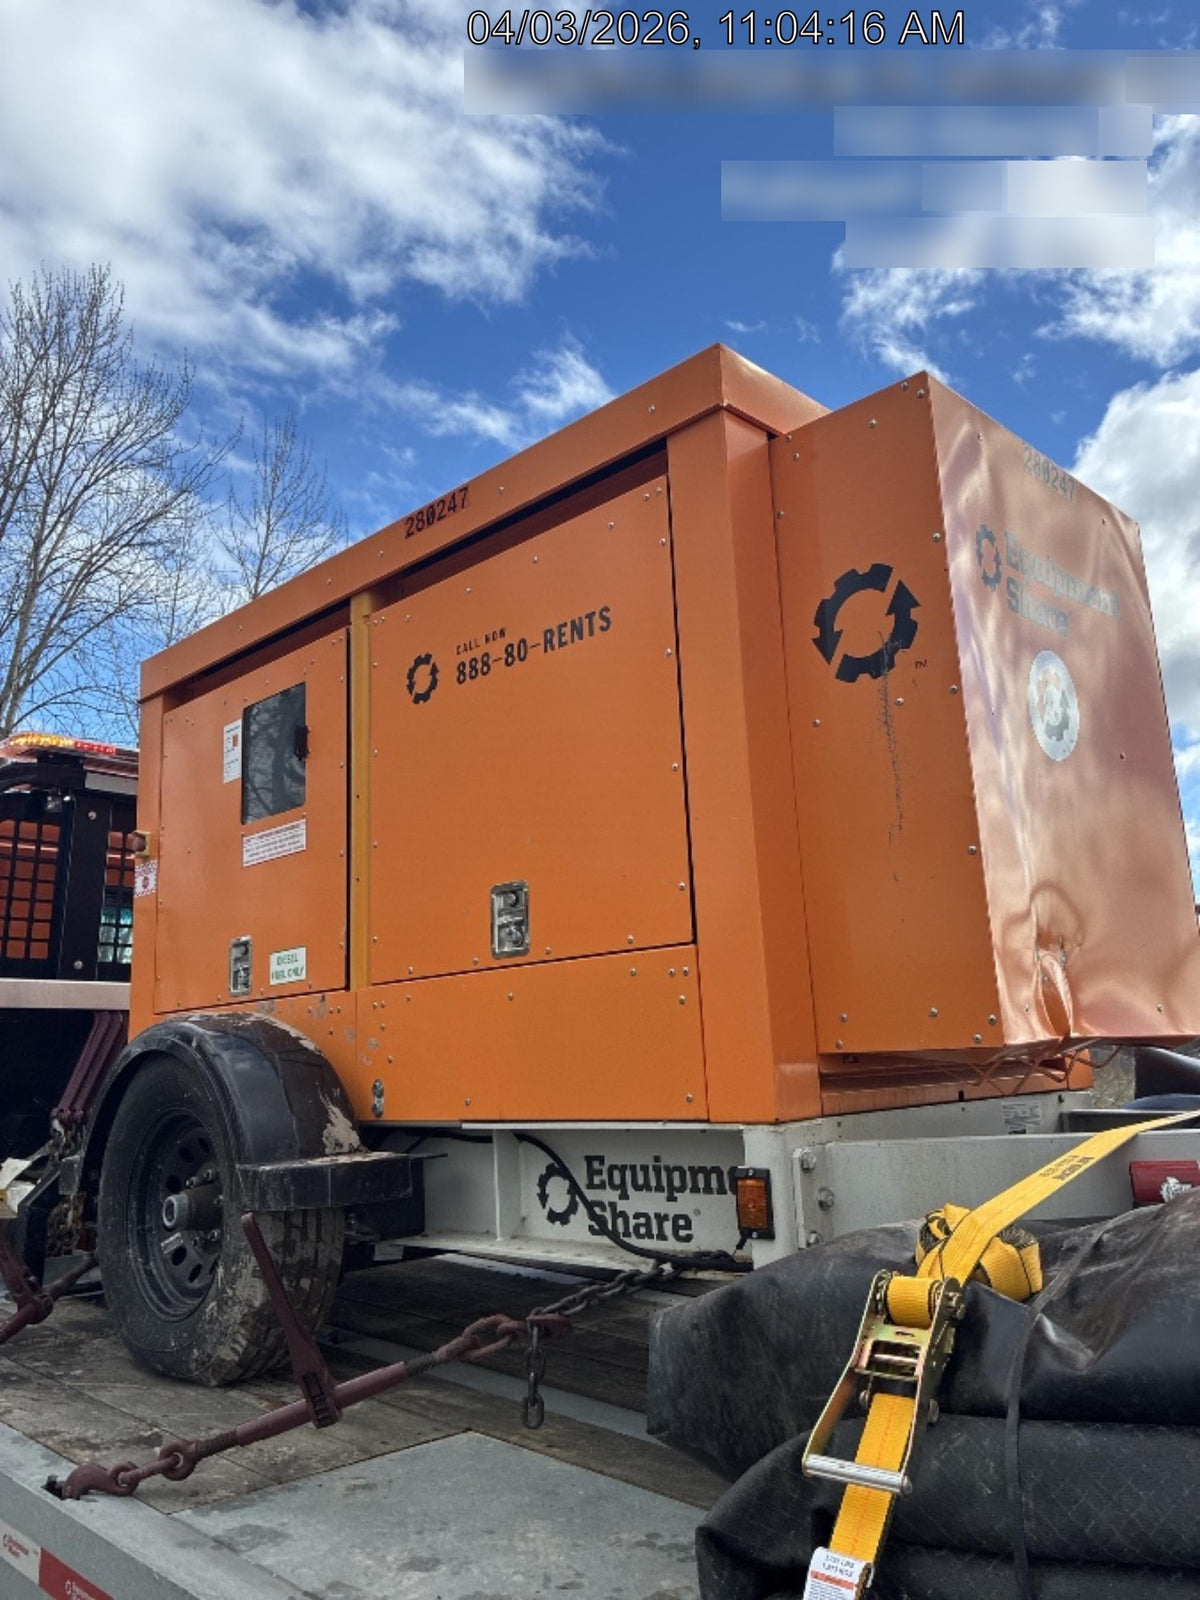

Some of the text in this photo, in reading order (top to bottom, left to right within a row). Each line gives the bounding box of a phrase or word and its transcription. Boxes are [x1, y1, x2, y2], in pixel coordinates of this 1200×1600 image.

[404, 486, 470, 539] 280247
[456, 627, 507, 655] CALL NOW
[456, 606, 612, 685] 888-80-RENTS
[588, 1200, 694, 1243] Share
